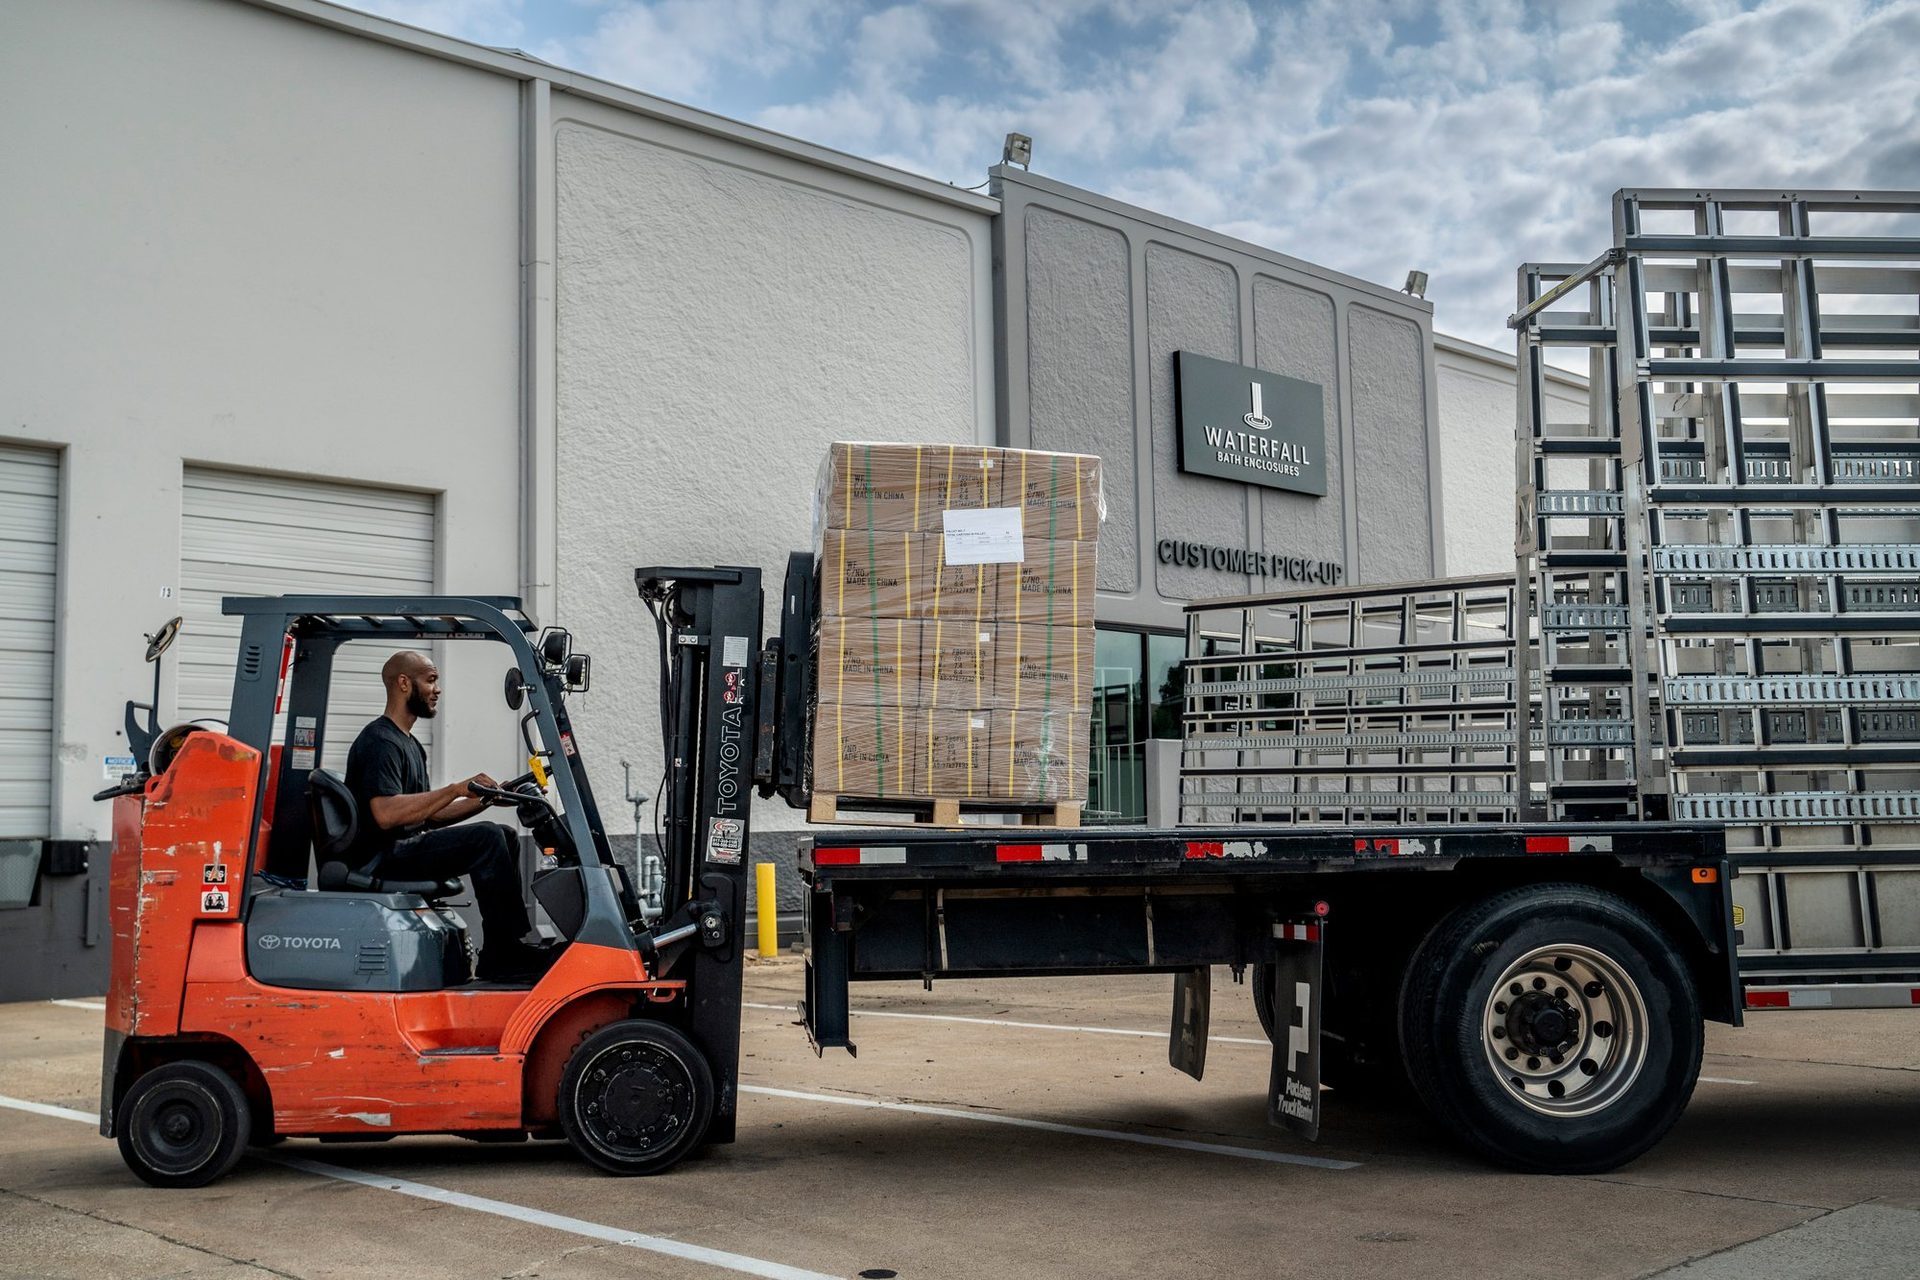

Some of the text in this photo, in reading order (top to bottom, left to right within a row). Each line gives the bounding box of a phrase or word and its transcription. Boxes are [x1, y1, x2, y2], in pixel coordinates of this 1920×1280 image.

[1204, 425, 1310, 465] WATERFALL
[1217, 451, 1300, 477] BATH ENCLOSURES
[1027, 482, 1038, 490] WF
[883, 491, 905, 500] CHINA
[1158, 539, 1343, 585] CUSTOMER PICK-UP
[877, 578, 898, 587] CHINA
[1022, 584, 1041, 592] MADE
[843, 665, 862, 673] MADE
[717, 707, 742, 815] TOYOTA
[283, 937, 341, 949] TOYOTA
